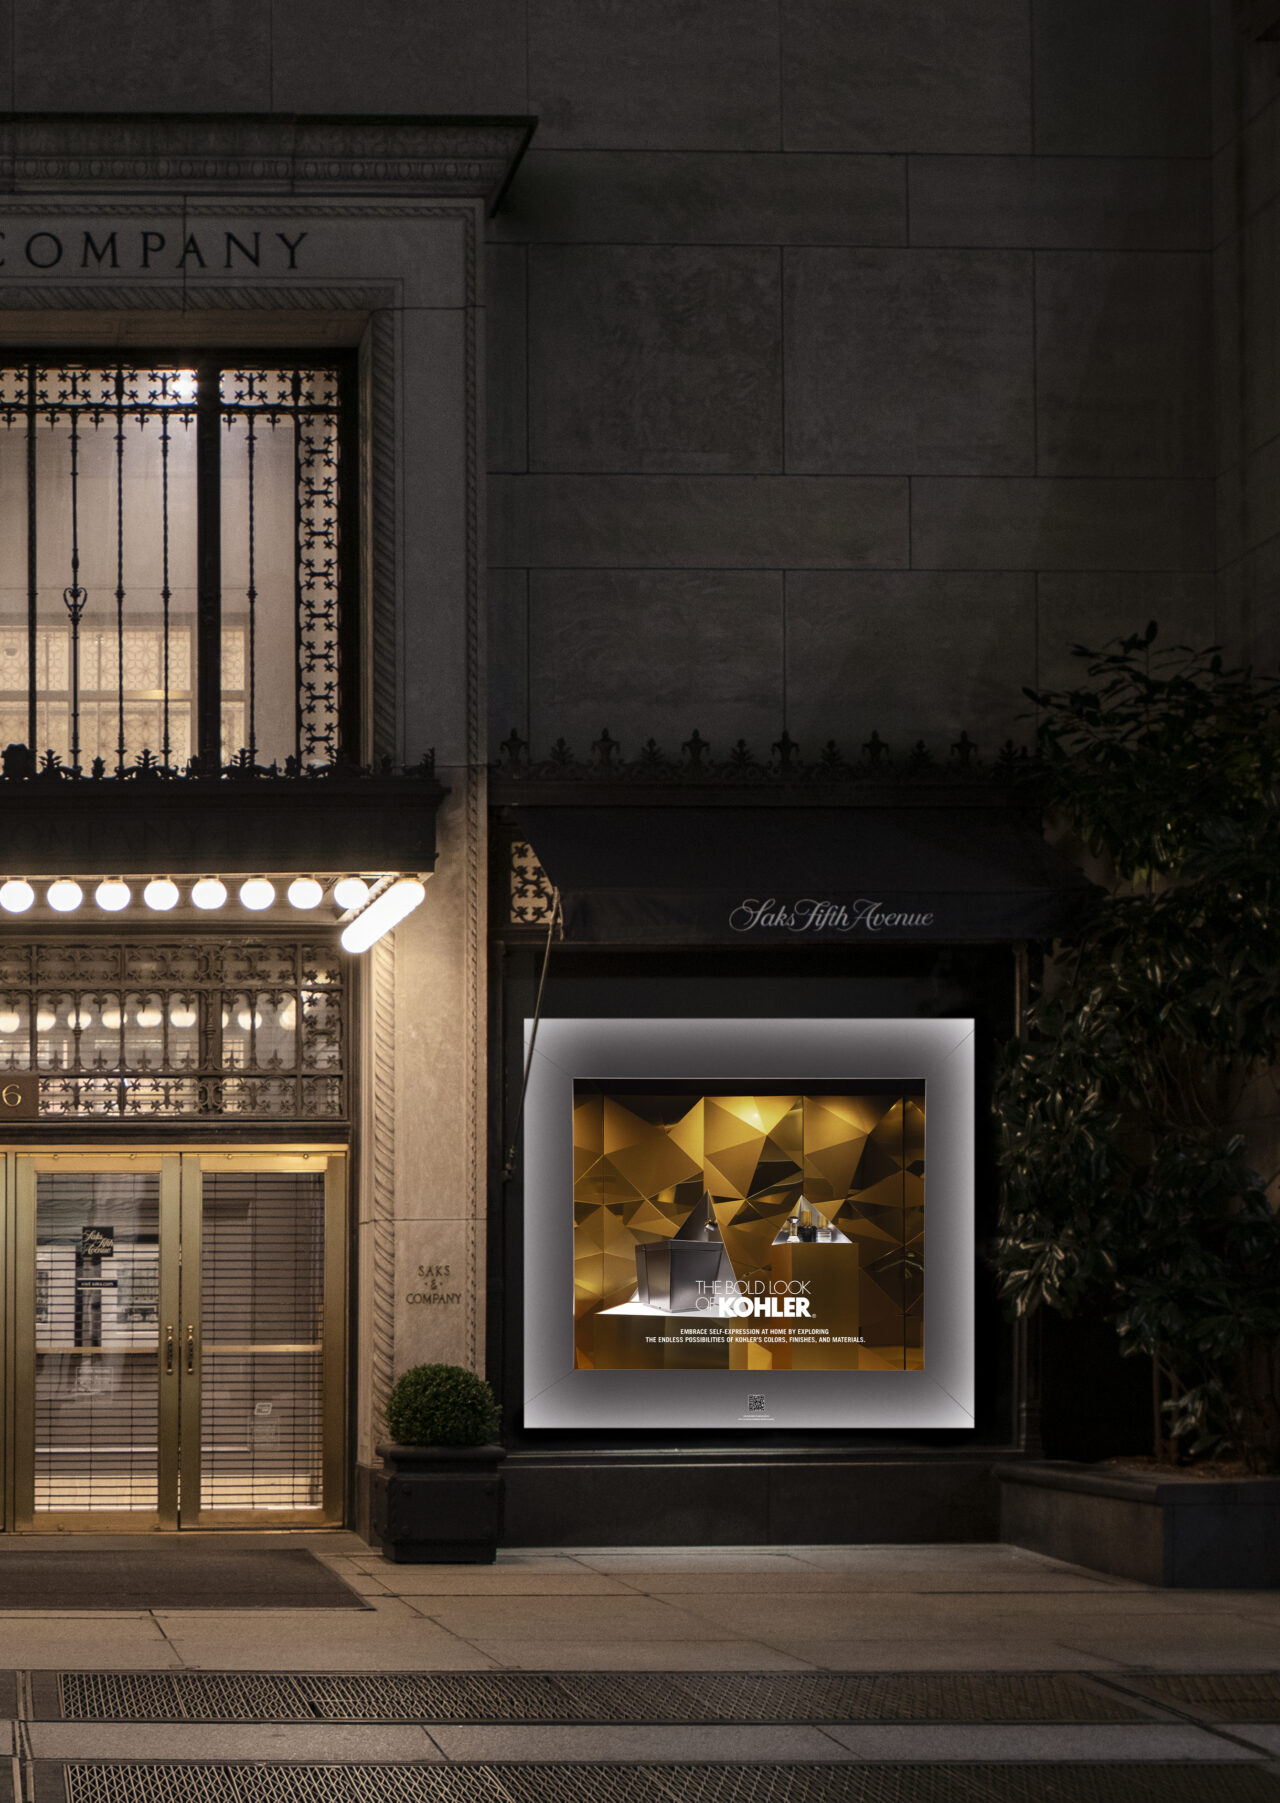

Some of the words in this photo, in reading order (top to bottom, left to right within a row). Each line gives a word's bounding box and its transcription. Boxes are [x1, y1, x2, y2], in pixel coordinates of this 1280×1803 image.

[729, 898, 795, 932] Saks
[788, 899, 849, 932] Fifth
[837, 899, 934, 932] Avenue
[2, 1083, 22, 1107] 6
[418, 1264, 450, 1277] SAKS
[695, 1280, 721, 1295] THE
[725, 1280, 766, 1295] BOLD
[769, 1280, 812, 1295] LOOK
[406, 1293, 461, 1305] COMPANY
[695, 1296, 716, 1311] OF
[763, 1336, 788, 1344] COLORS,
[789, 1336, 818, 1344] FINISHES,
